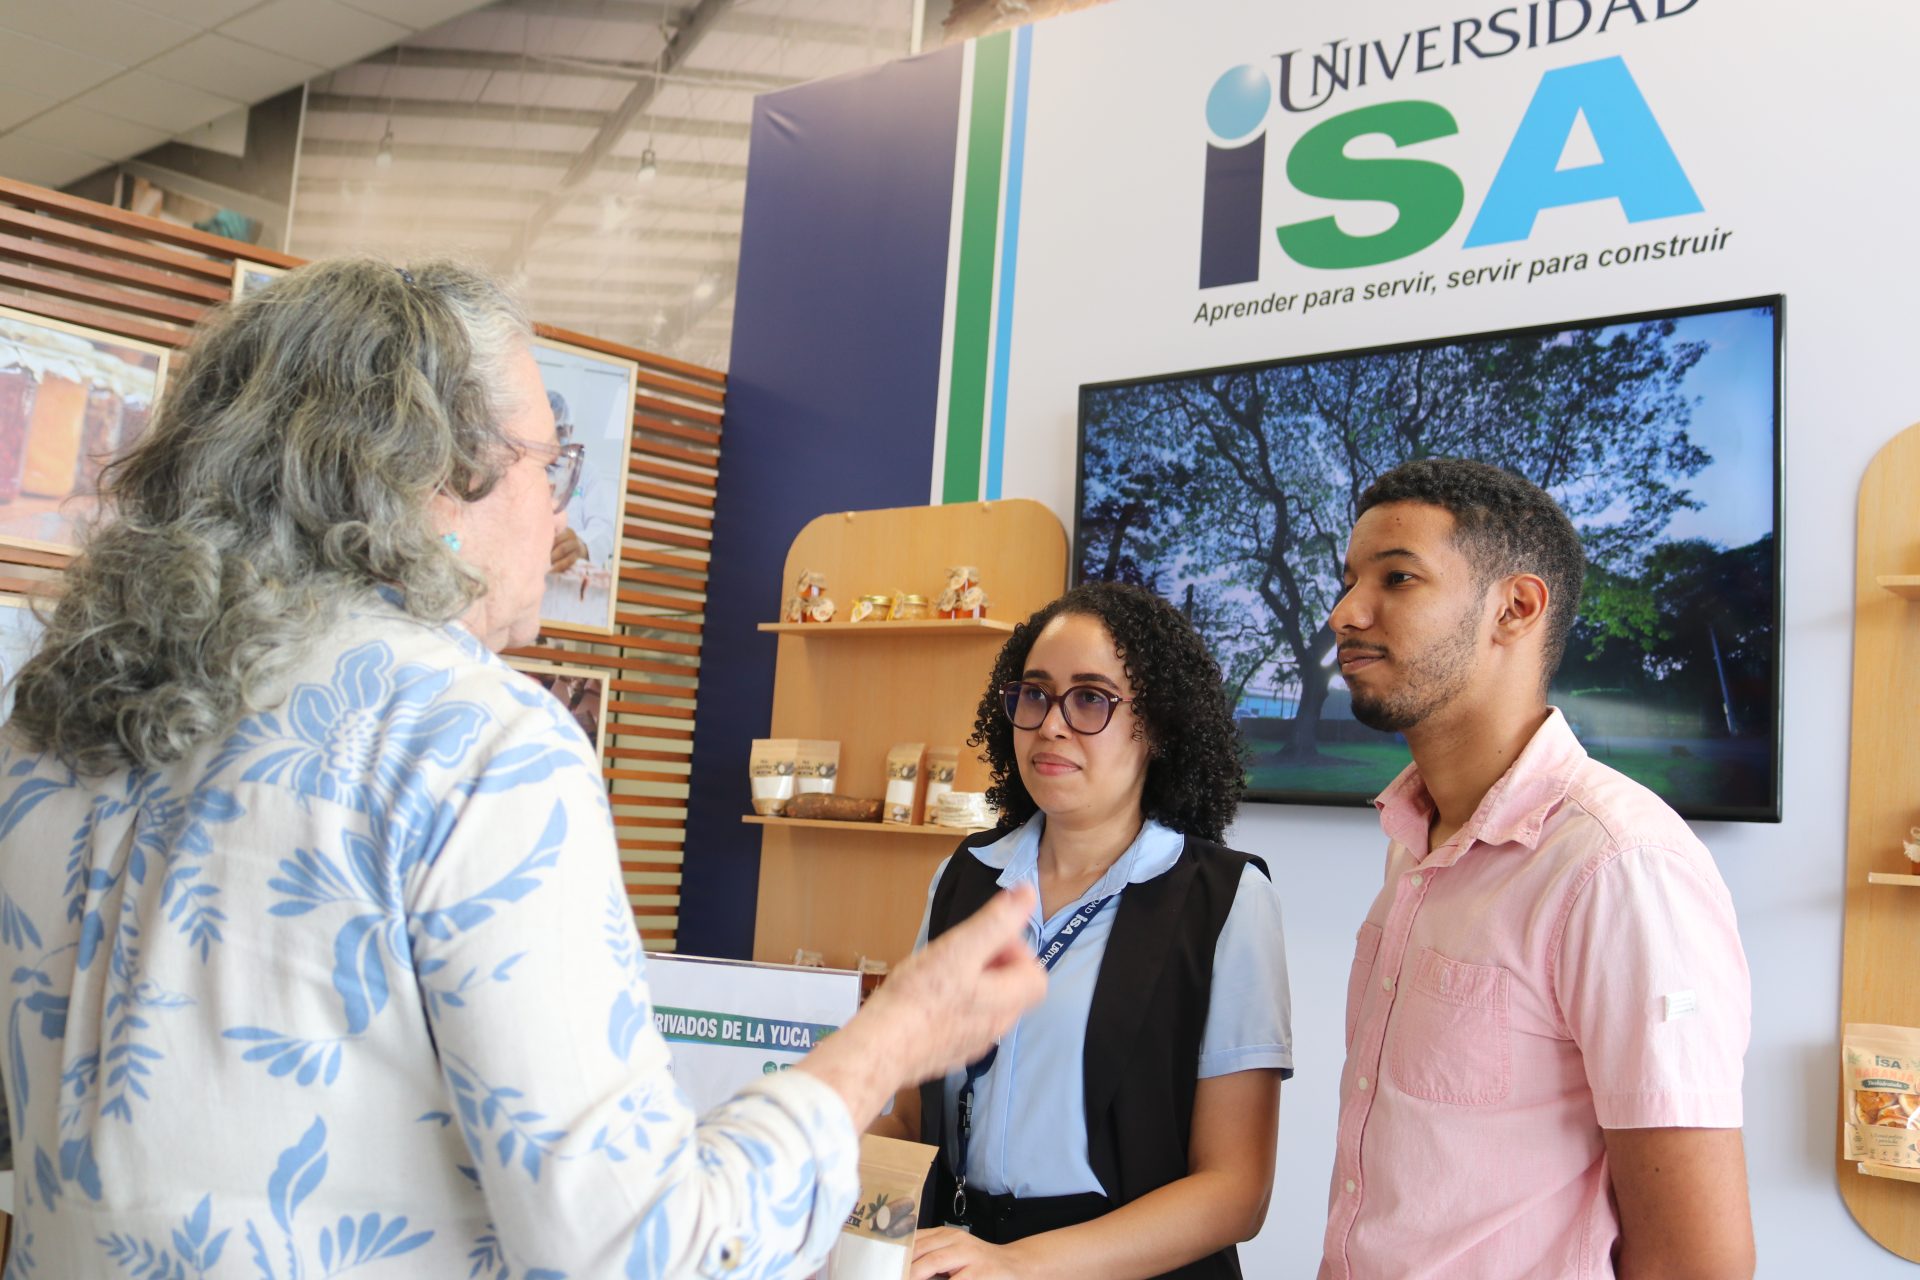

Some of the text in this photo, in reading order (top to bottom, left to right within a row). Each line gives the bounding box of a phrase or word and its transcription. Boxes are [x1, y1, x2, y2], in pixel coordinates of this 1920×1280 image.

[1193, 227, 1733, 327] Aprender para servir, servir para construir
[653, 1012, 811, 1048] RIVADOS DE LA YUCA
